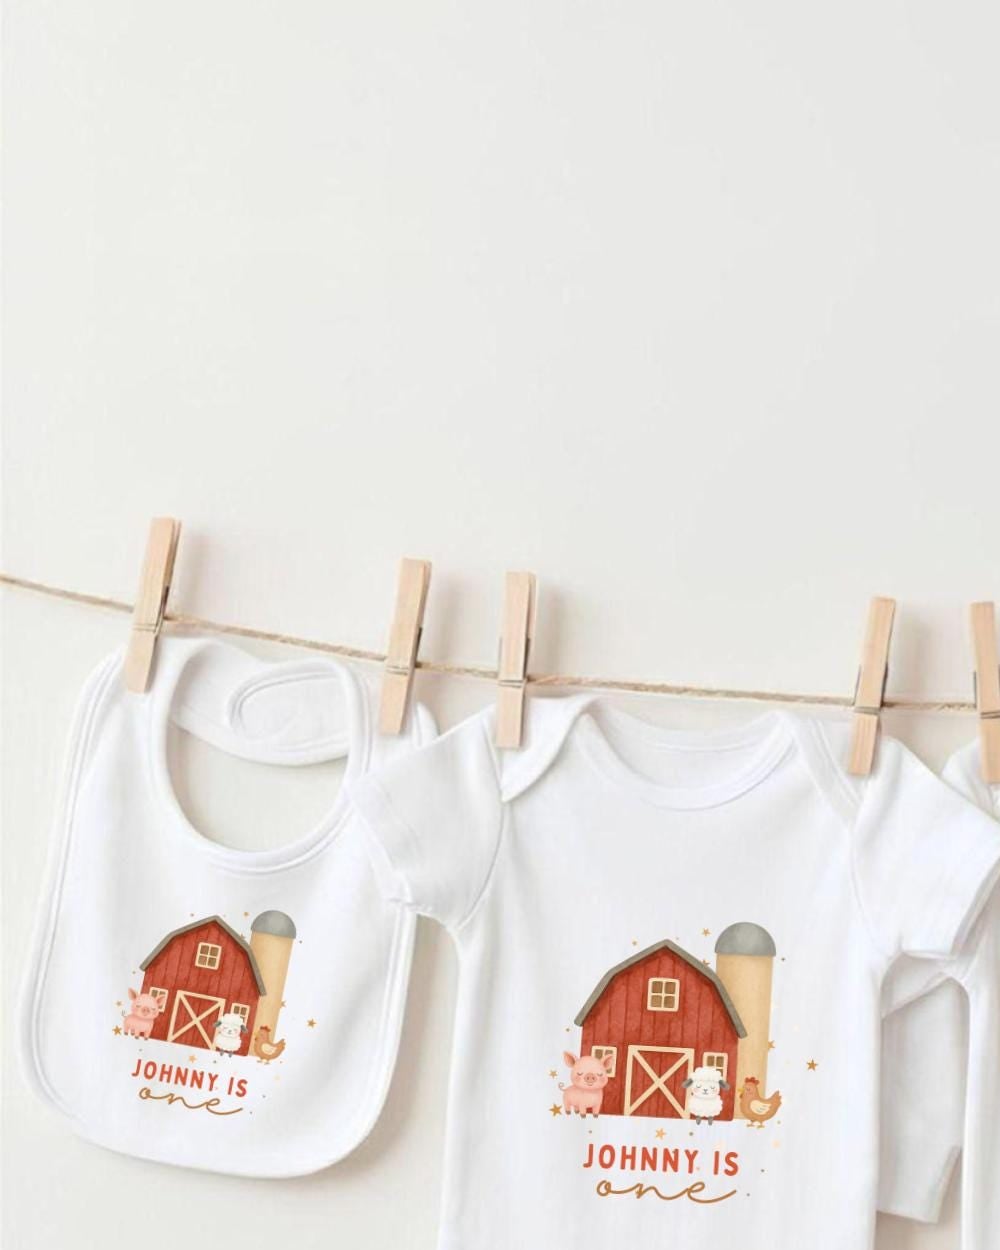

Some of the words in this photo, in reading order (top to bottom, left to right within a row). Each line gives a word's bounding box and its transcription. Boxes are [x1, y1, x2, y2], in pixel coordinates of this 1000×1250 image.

[132, 1059, 219, 1092] JOHNNY
[227, 1077, 248, 1098] IS
[139, 1086, 243, 1115] one
[583, 1143, 699, 1174] JOHNNY
[713, 1151, 740, 1177] IS
[596, 1180, 737, 1204] one
